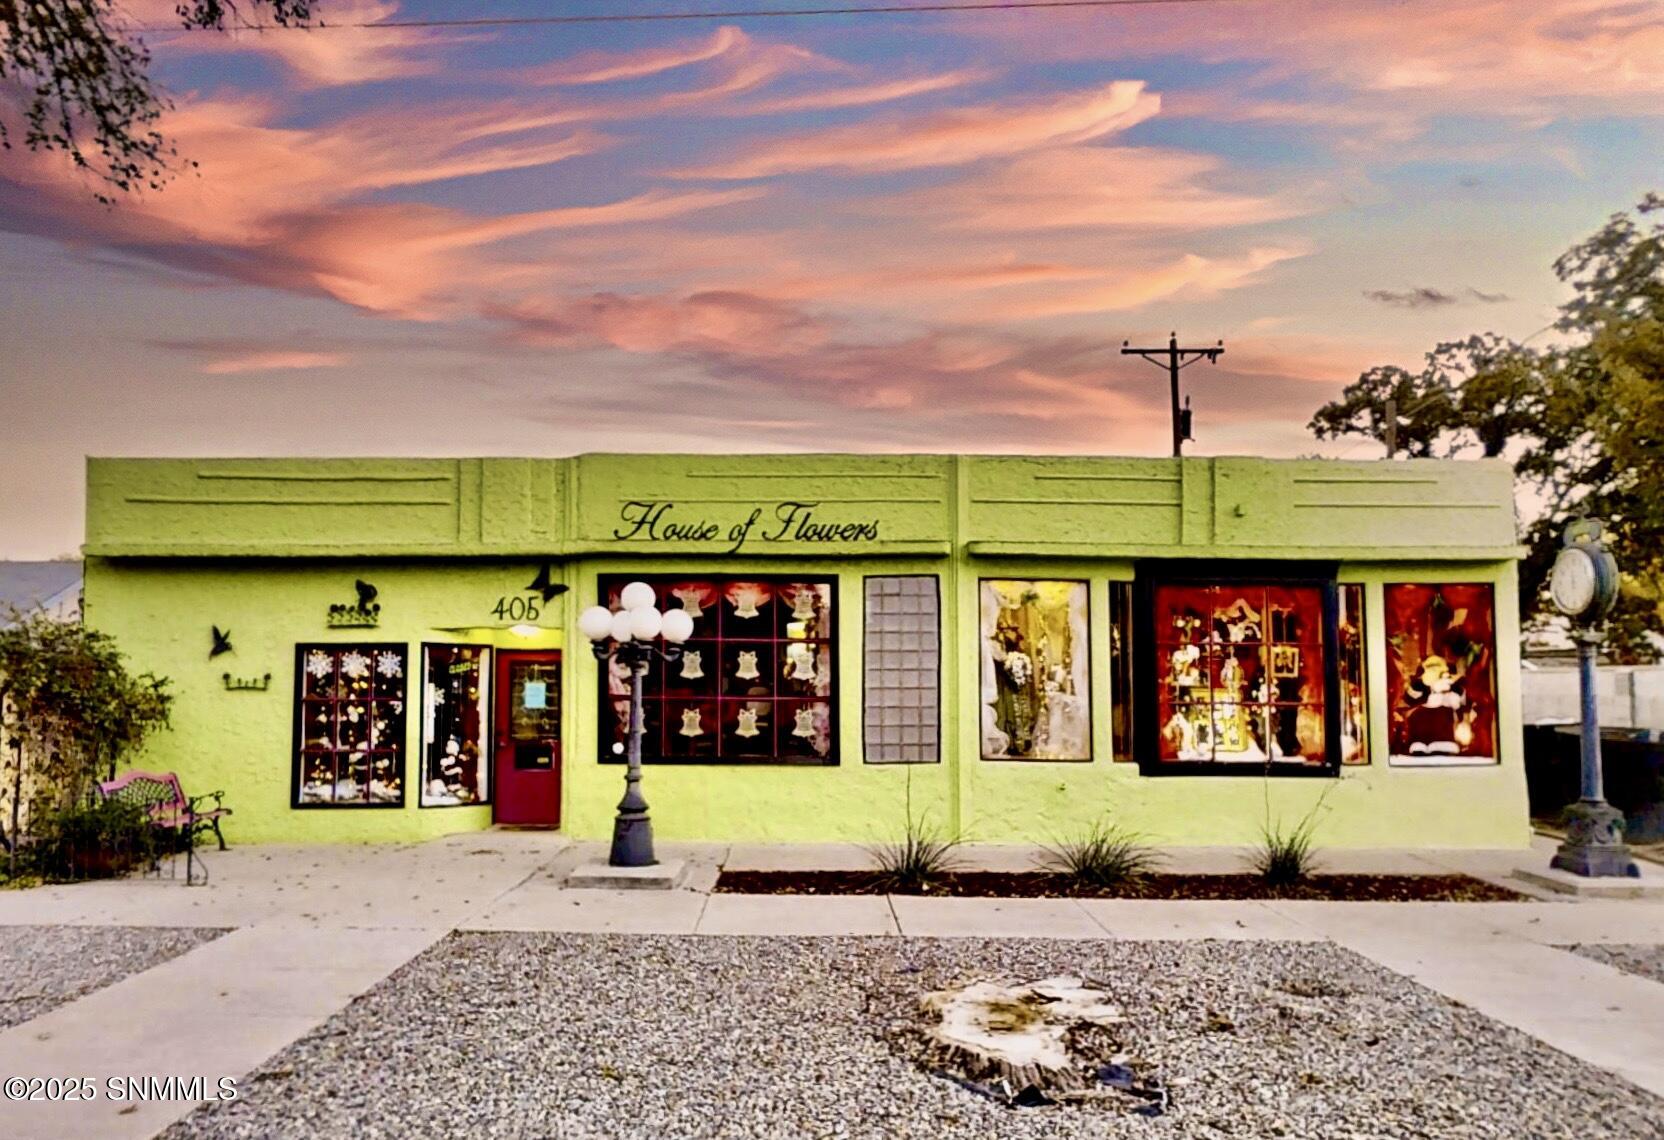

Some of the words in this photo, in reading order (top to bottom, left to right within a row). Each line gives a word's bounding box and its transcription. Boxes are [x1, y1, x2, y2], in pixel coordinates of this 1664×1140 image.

[613, 501, 719, 541] House
[728, 507, 762, 554] of
[762, 501, 880, 542] Flowers
[490, 596, 539, 621] 405
